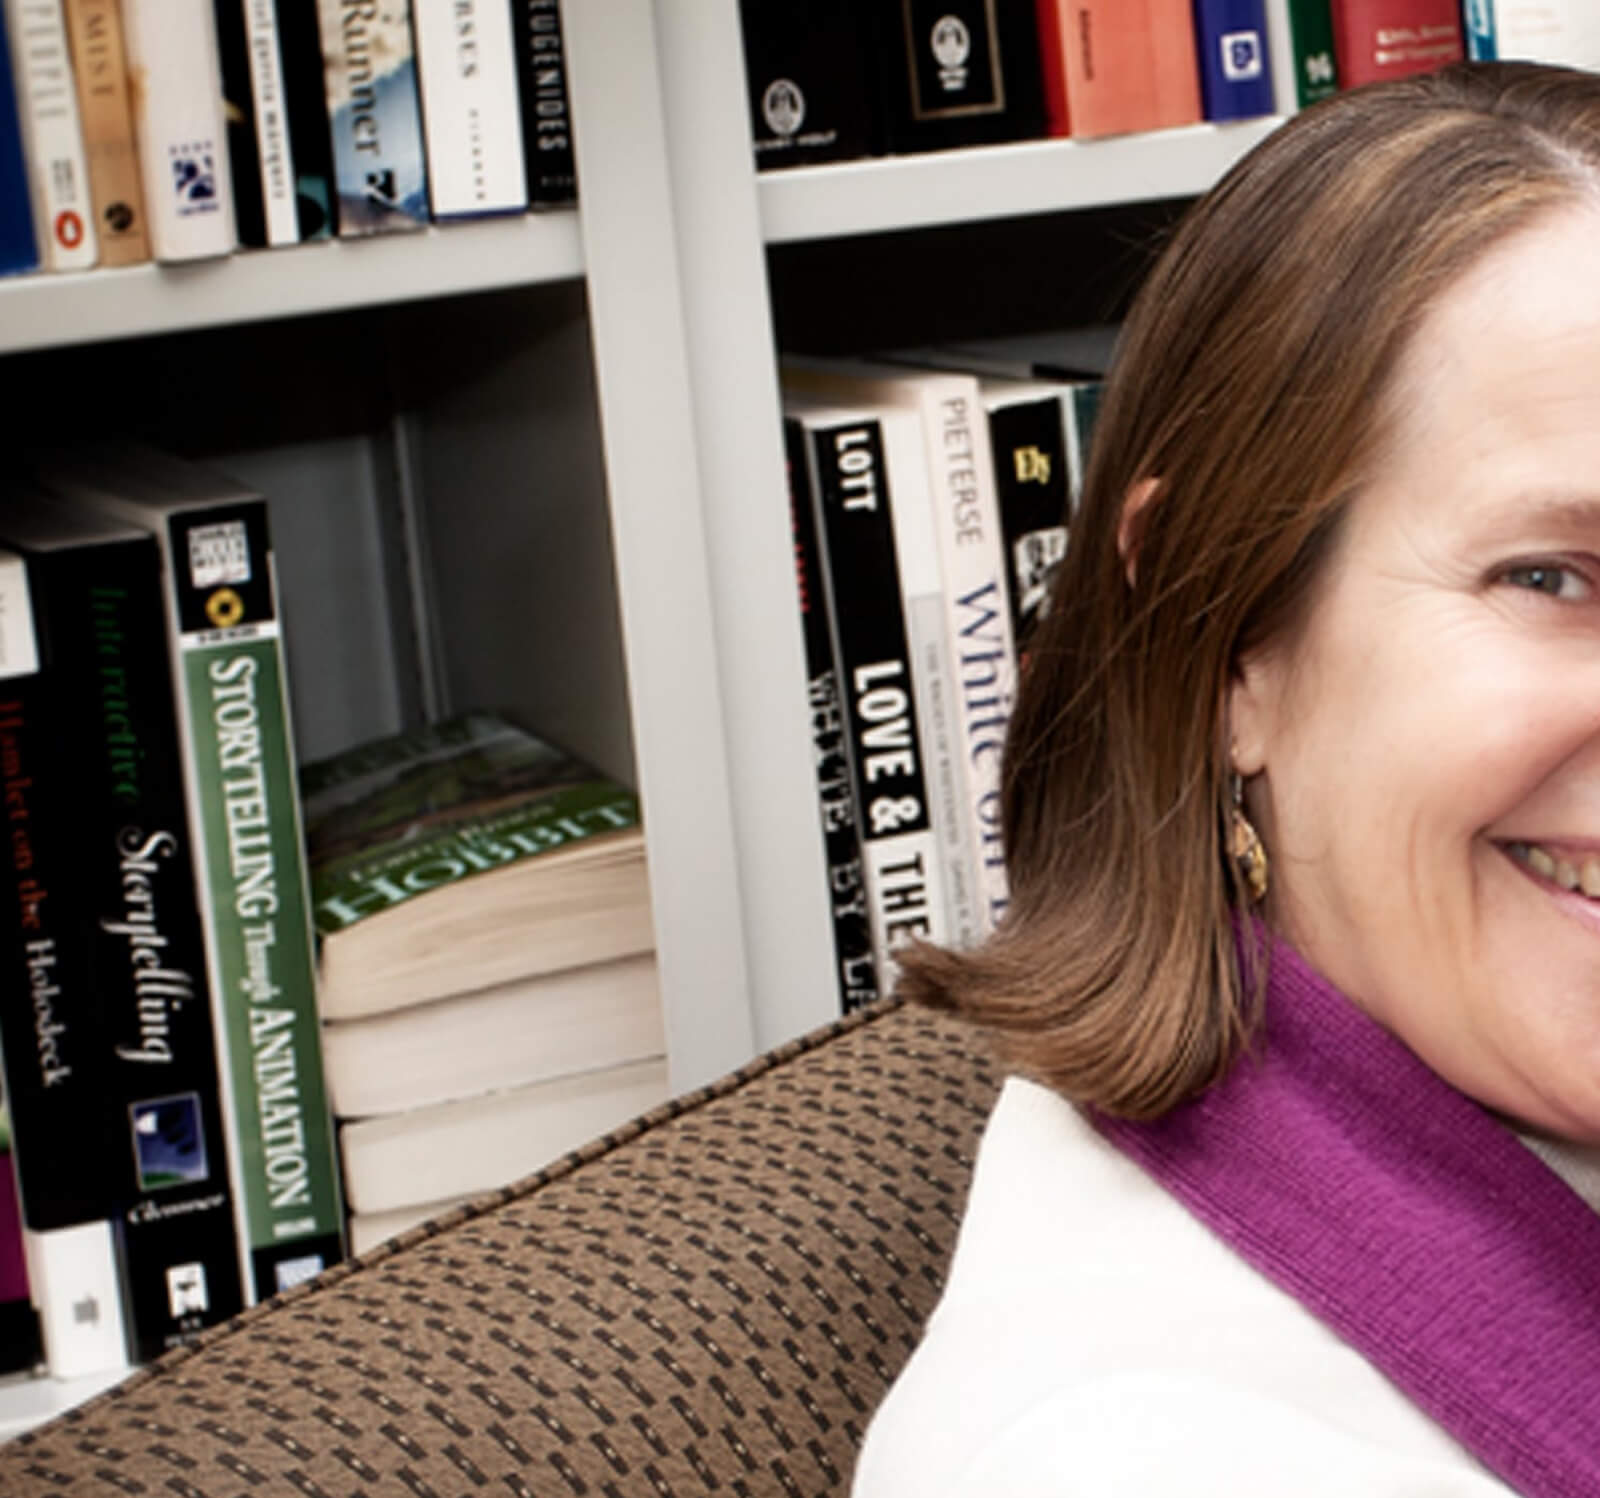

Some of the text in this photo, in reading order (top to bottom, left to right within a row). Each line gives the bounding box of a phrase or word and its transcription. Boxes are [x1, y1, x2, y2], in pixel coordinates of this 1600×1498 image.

[834, 428, 878, 512] LOTT
[940, 396, 984, 546] PIETERSE
[90, 583, 144, 801] Interactive
[808, 668, 854, 832] WHITE
[853, 660, 916, 783] LOVE
[955, 580, 1007, 771] White
[210, 653, 281, 920] STORYTELLING
[869, 795, 921, 834] &
[322, 801, 634, 925] HOBBIT
[25, 938, 72, 1088] Holodeck
[100, 822, 192, 1065] Storytelling
[235, 924, 284, 1005] Through
[248, 1006, 315, 1210] ANIMATION
